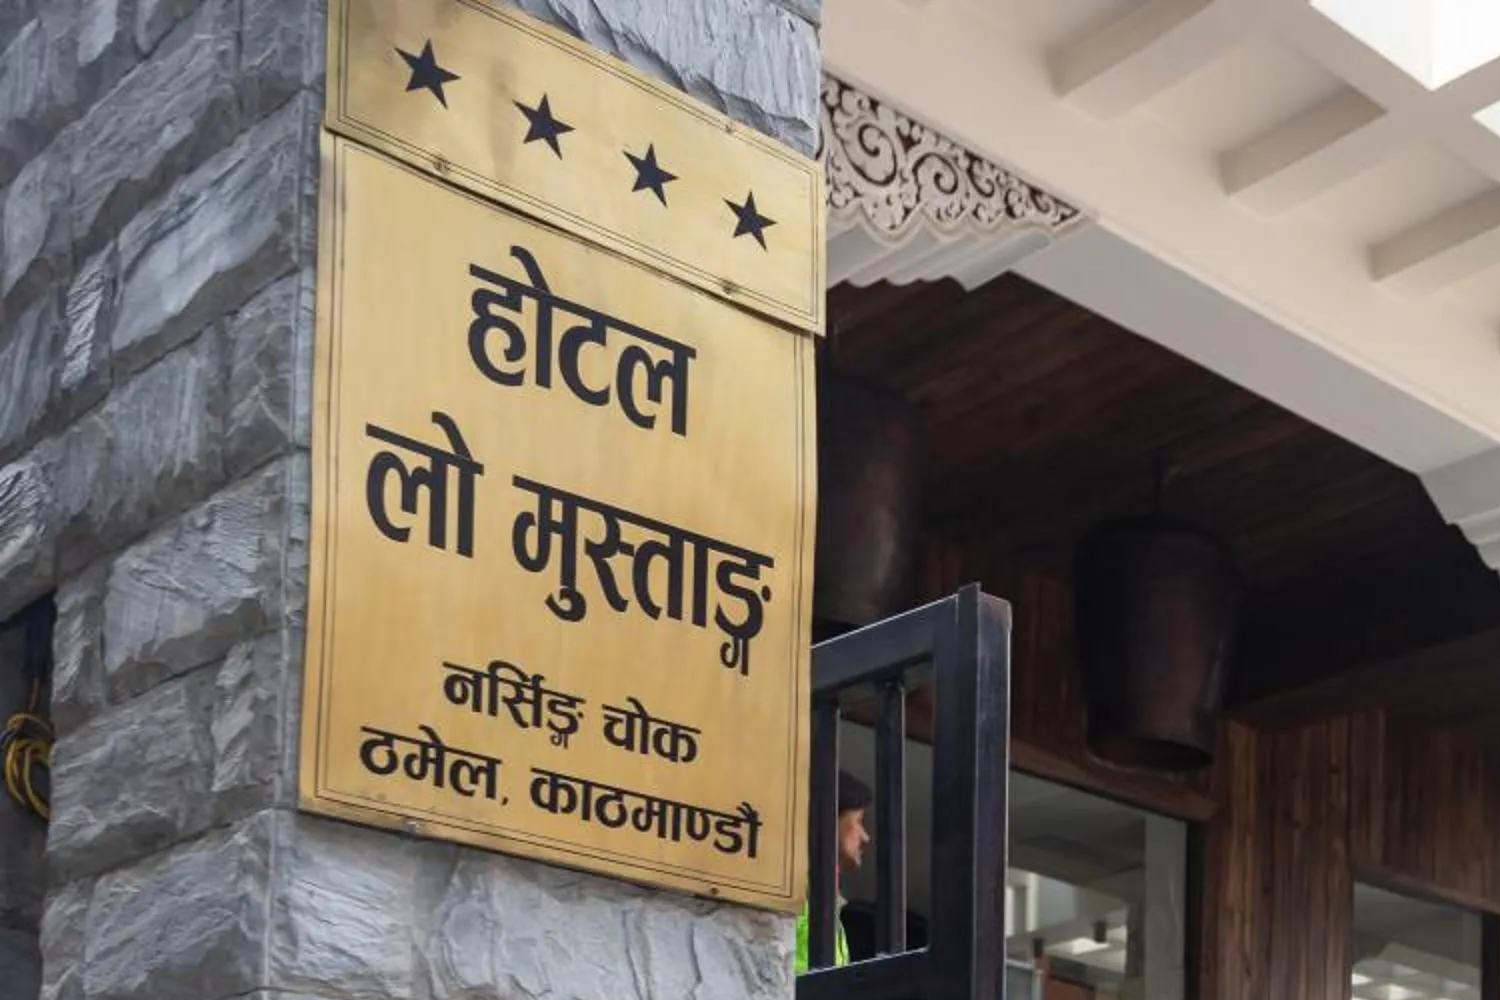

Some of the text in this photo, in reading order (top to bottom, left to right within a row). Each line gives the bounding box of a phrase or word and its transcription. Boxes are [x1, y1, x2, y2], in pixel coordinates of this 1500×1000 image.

[468, 246, 697, 437] होटल
[366, 411, 774, 677] लो मुस्ताङ्ग
[601, 696, 702, 763] चोक
[529, 767, 763, 859] काठमाण्डौ
